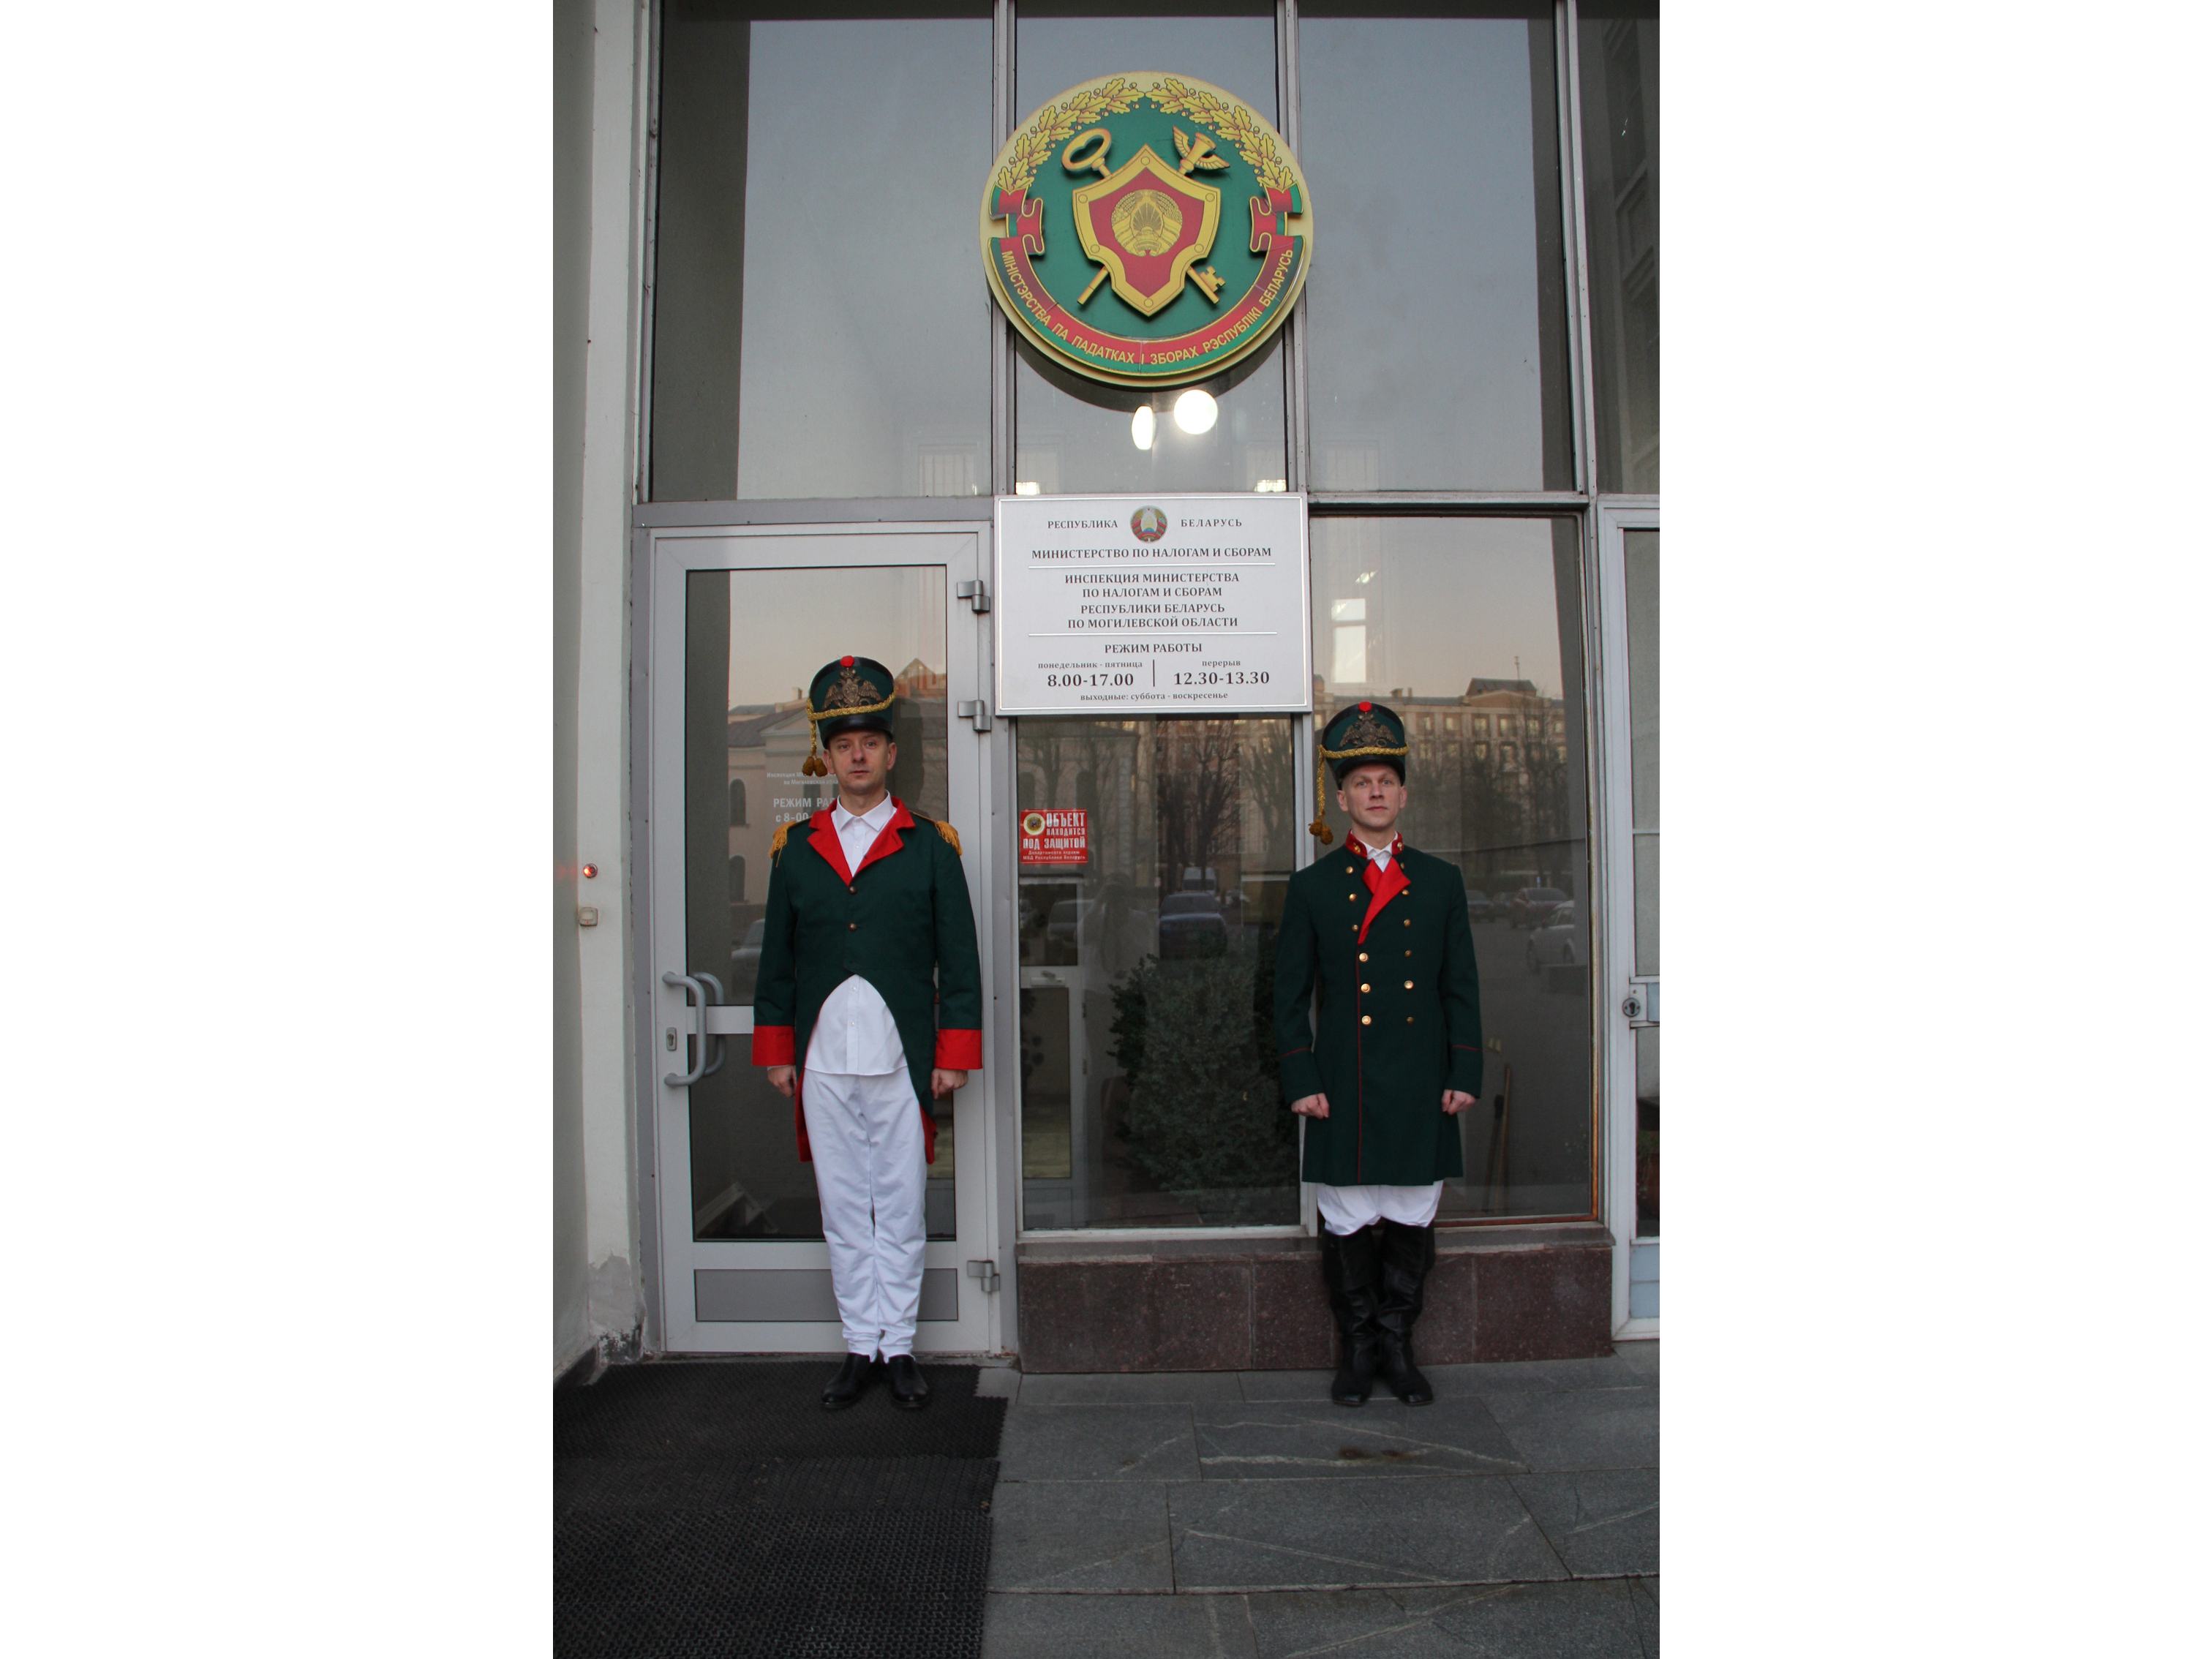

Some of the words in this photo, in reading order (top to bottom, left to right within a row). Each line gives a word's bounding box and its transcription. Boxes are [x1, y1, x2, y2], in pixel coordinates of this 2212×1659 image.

[1001, 250, 1052, 326] МІНІСТЭРСТВА
[1053, 323, 1068, 340] ПА
[1072, 336, 1134, 364] ПАДАТКАХ
[1150, 348, 1198, 365] ЗБОРАХ
[1203, 306, 1261, 353] РЭСПУБЛІКІ
[1258, 249, 1293, 306] БЕЛАРУСЬ
[1047, 519, 1118, 530] РЕСПУБЛИКА
[1181, 519, 1242, 527] БЕЛАРУСЬ
[1031, 549, 1129, 559] МИНИСТЕРСТВО
[1132, 548, 1149, 557] ПО
[1152, 548, 1209, 557] НАЛОГАМ
[1213, 548, 1221, 557] И
[1224, 547, 1271, 557] СБОРАМ
[1065, 573, 1139, 585] ИНСПЕКЦИЯ
[1143, 573, 1239, 583] МИНИСТЕРСТВА
[1083, 588, 1099, 598] ПО
[1102, 587, 1159, 598] НАЛОГАМ
[1163, 587, 1171, 597] И
[1175, 587, 1222, 596] СБОРАМ
[1080, 604, 1162, 614] РЕСПУБЛИКИ
[1165, 603, 1225, 613] БЕЛАРУСЬ
[1068, 619, 1084, 628] ПО
[1088, 616, 1178, 628] МОГИЛЕВСКОЙ
[1181, 617, 1238, 627] ОБЛАСТИ
[1105, 644, 1150, 654] РЕЖИМ
[1153, 643, 1202, 652] РАБОТЫ
[1105, 661, 1143, 669] пятница
[1202, 659, 1241, 668] перерыв
[1047, 673, 1134, 687] 8.00-17.00
[1174, 672, 1270, 685] 12.30-13.30
[1080, 693, 1129, 701] выходные:
[1130, 692, 1165, 701] суббота
[1173, 692, 1228, 701] воскресенье
[774, 798, 811, 808] РЕЖИМ
[784, 813, 808, 822] 8-00
[1046, 813, 1084, 827] ОБЪЕКТ
[1047, 828, 1085, 836] НАХОДИТСЯ
[1023, 838, 1039, 850] ПОД
[1044, 836, 1086, 849] ЗАЩИТОЙ
